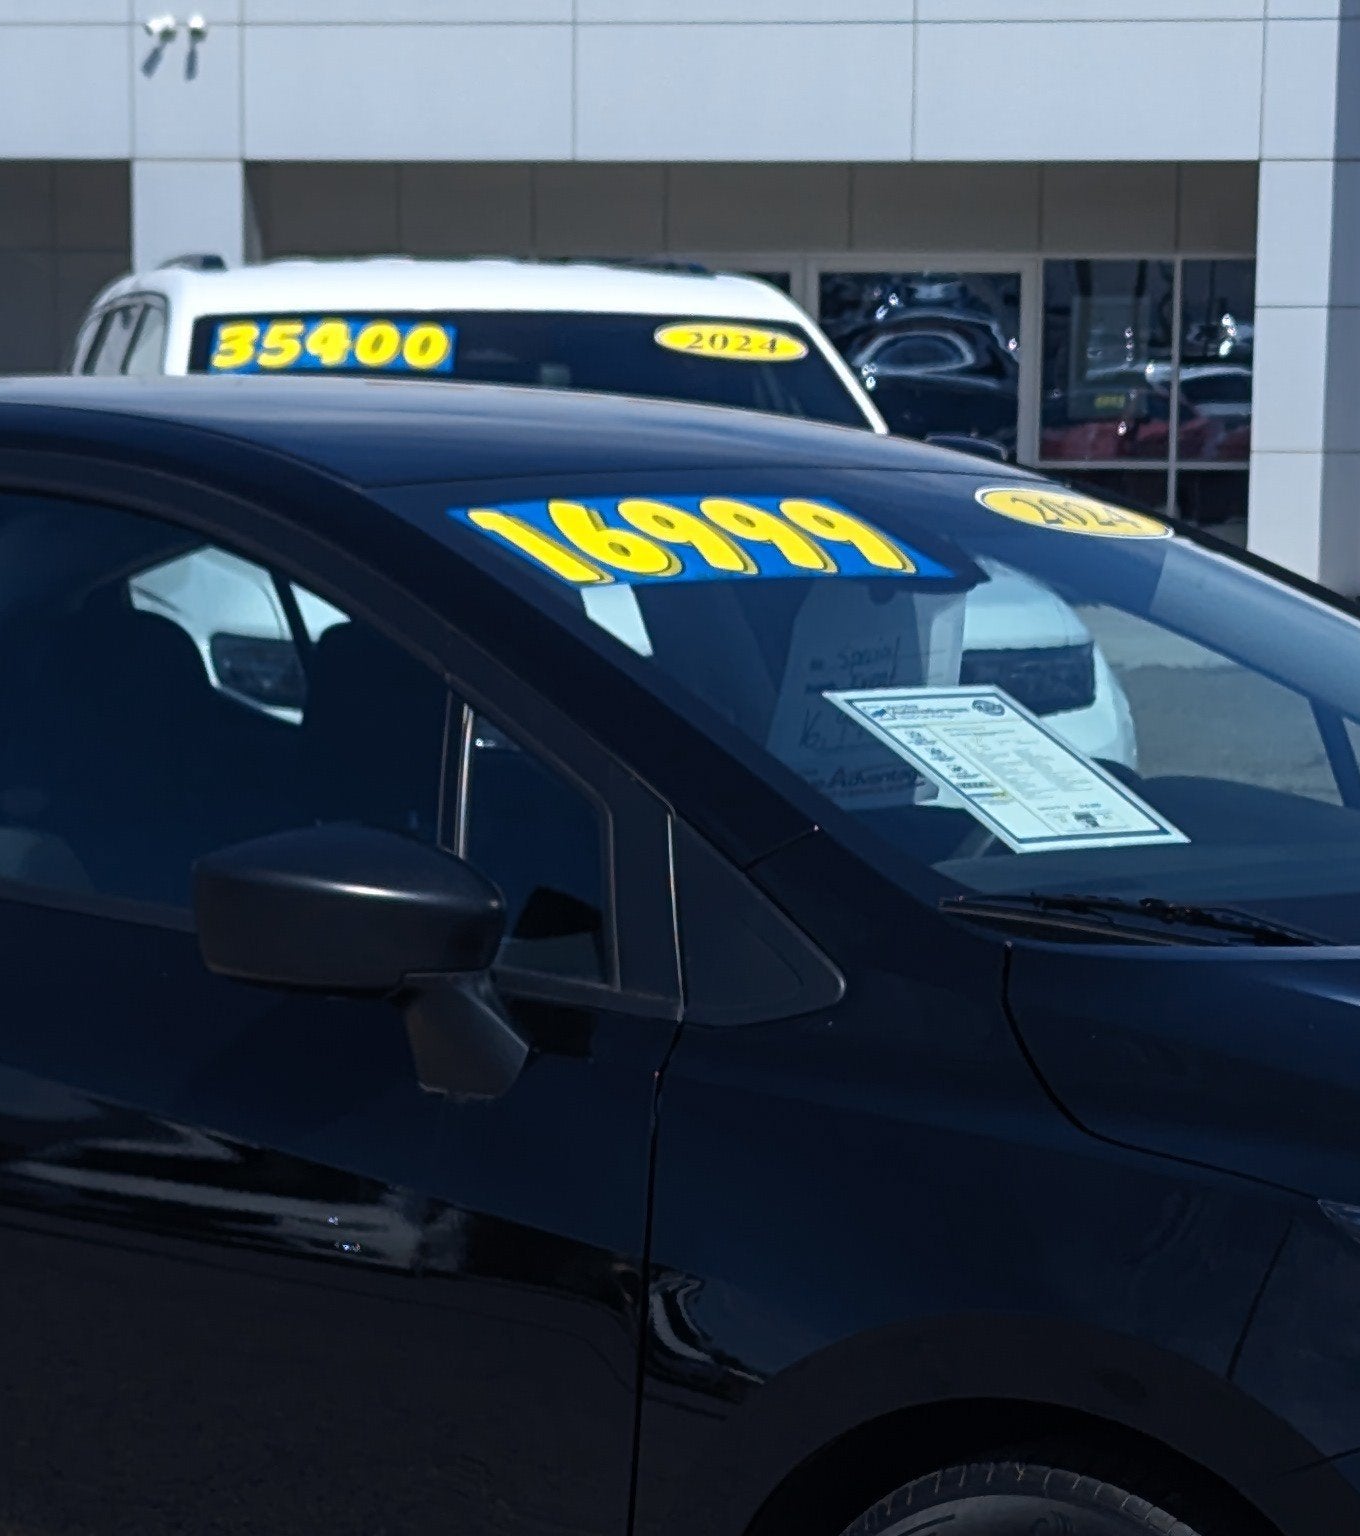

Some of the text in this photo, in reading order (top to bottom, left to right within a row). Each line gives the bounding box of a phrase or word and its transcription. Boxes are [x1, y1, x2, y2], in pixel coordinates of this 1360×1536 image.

[211, 318, 450, 371] 35400
[685, 330, 780, 356] 2024
[1010, 496, 1142, 527] 2024
[467, 498, 916, 584] 16999
